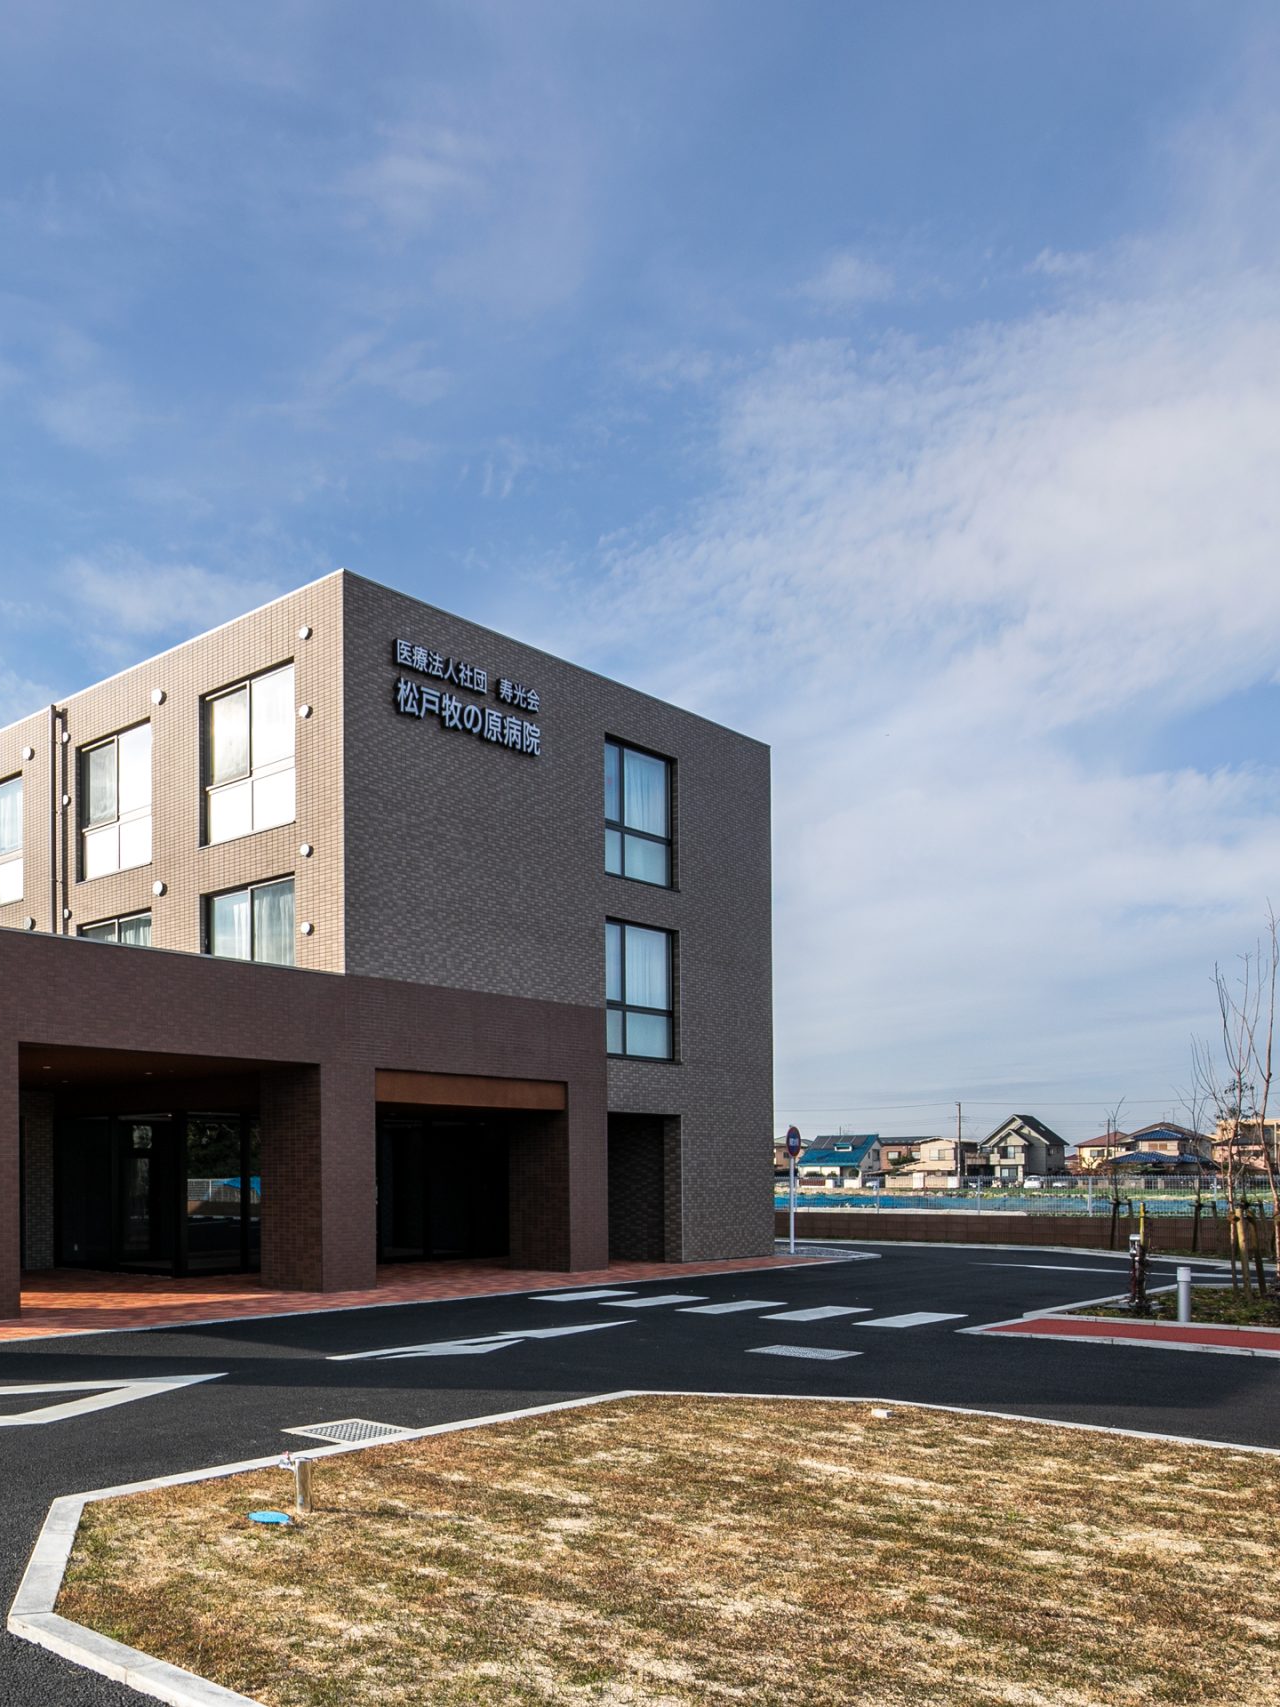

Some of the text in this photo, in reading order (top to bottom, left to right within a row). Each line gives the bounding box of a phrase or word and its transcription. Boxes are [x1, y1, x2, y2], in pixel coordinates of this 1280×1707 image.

[396, 639, 540, 713] 医療法人社団 寿光会
[397, 677, 541, 756] 松戸牧の原病院
